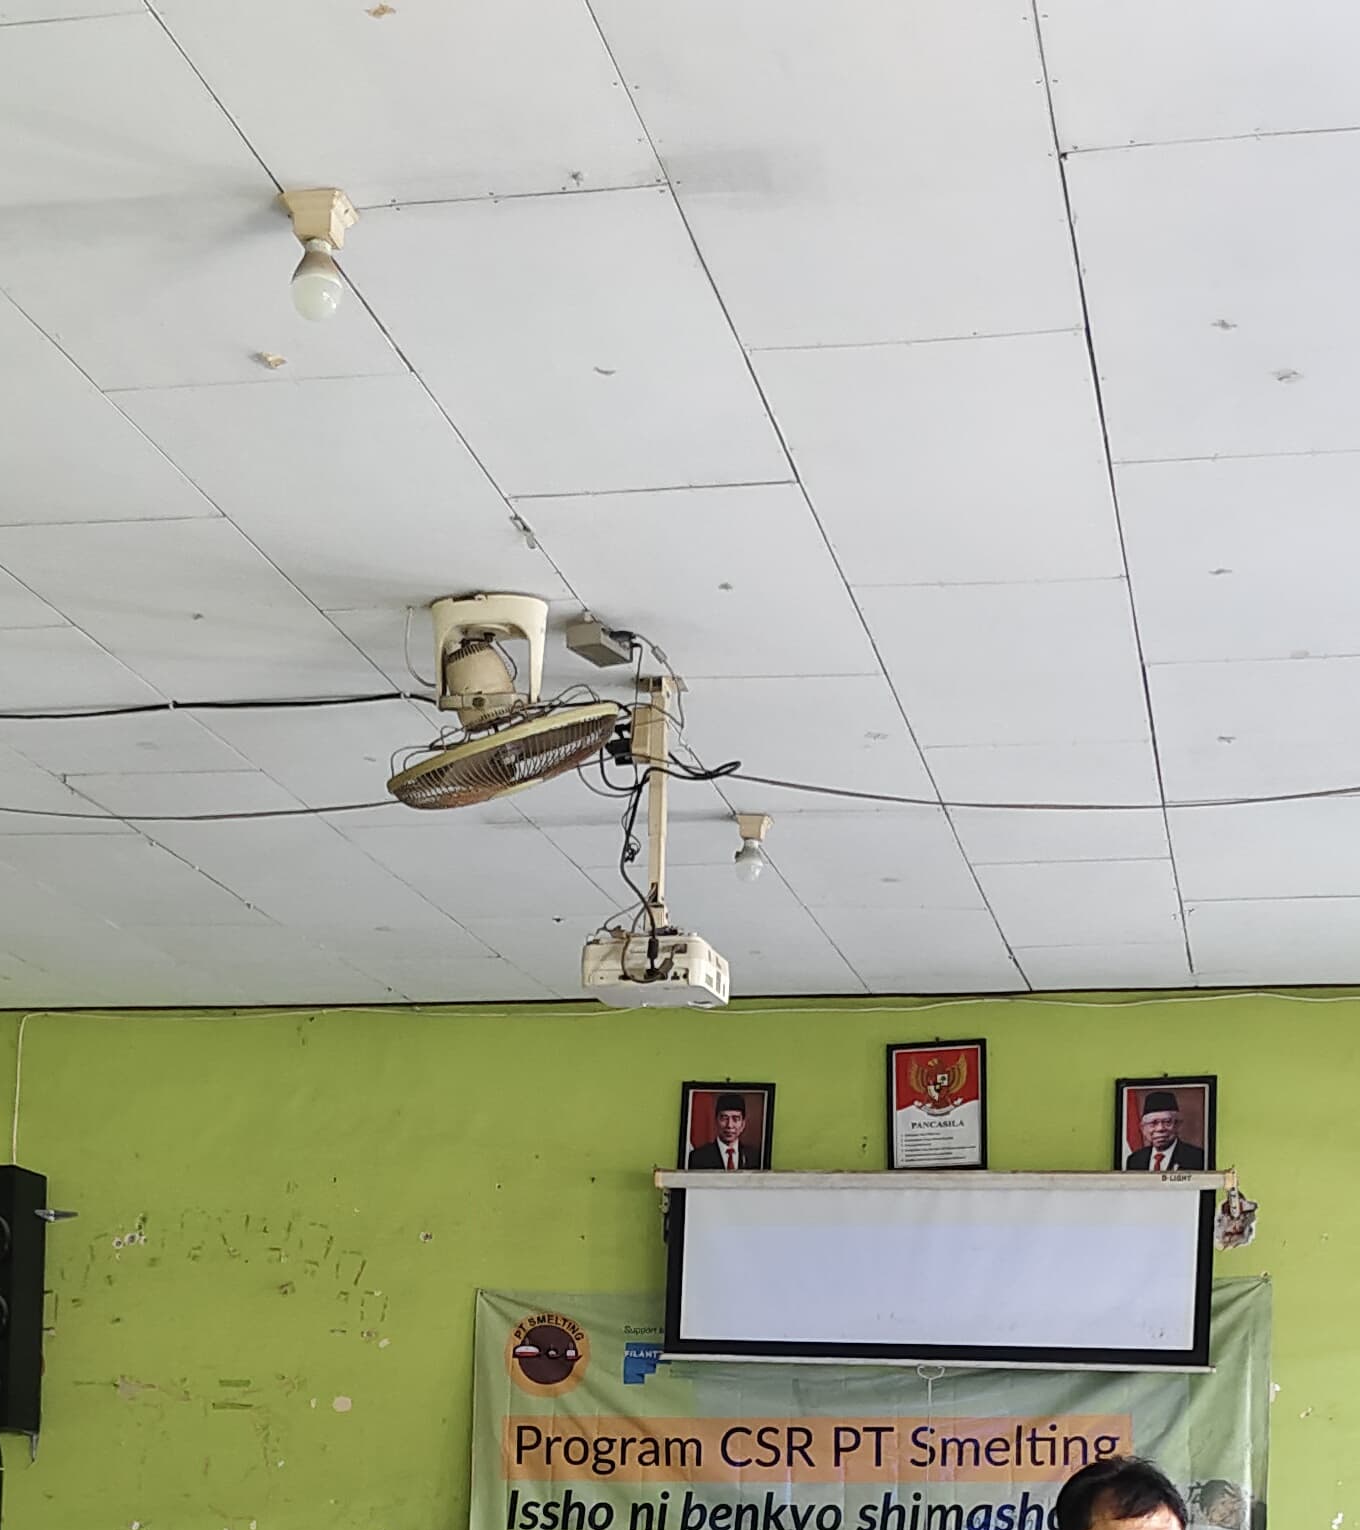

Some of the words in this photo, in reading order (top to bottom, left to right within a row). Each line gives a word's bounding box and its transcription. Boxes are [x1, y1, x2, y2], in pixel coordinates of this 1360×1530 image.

[911, 1120, 965, 1130] PANCASILA
[514, 1323, 528, 1341] PT
[528, 1314, 585, 1341] SMELTING
[624, 1325, 657, 1336] Support
[624, 1350, 663, 1359] FILANT
[516, 1425, 702, 1475] Program
[721, 1426, 816, 1467] CSR
[833, 1426, 894, 1467] PT
[910, 1424, 1120, 1467] Smelting
[507, 1490, 614, 1530] Issho
